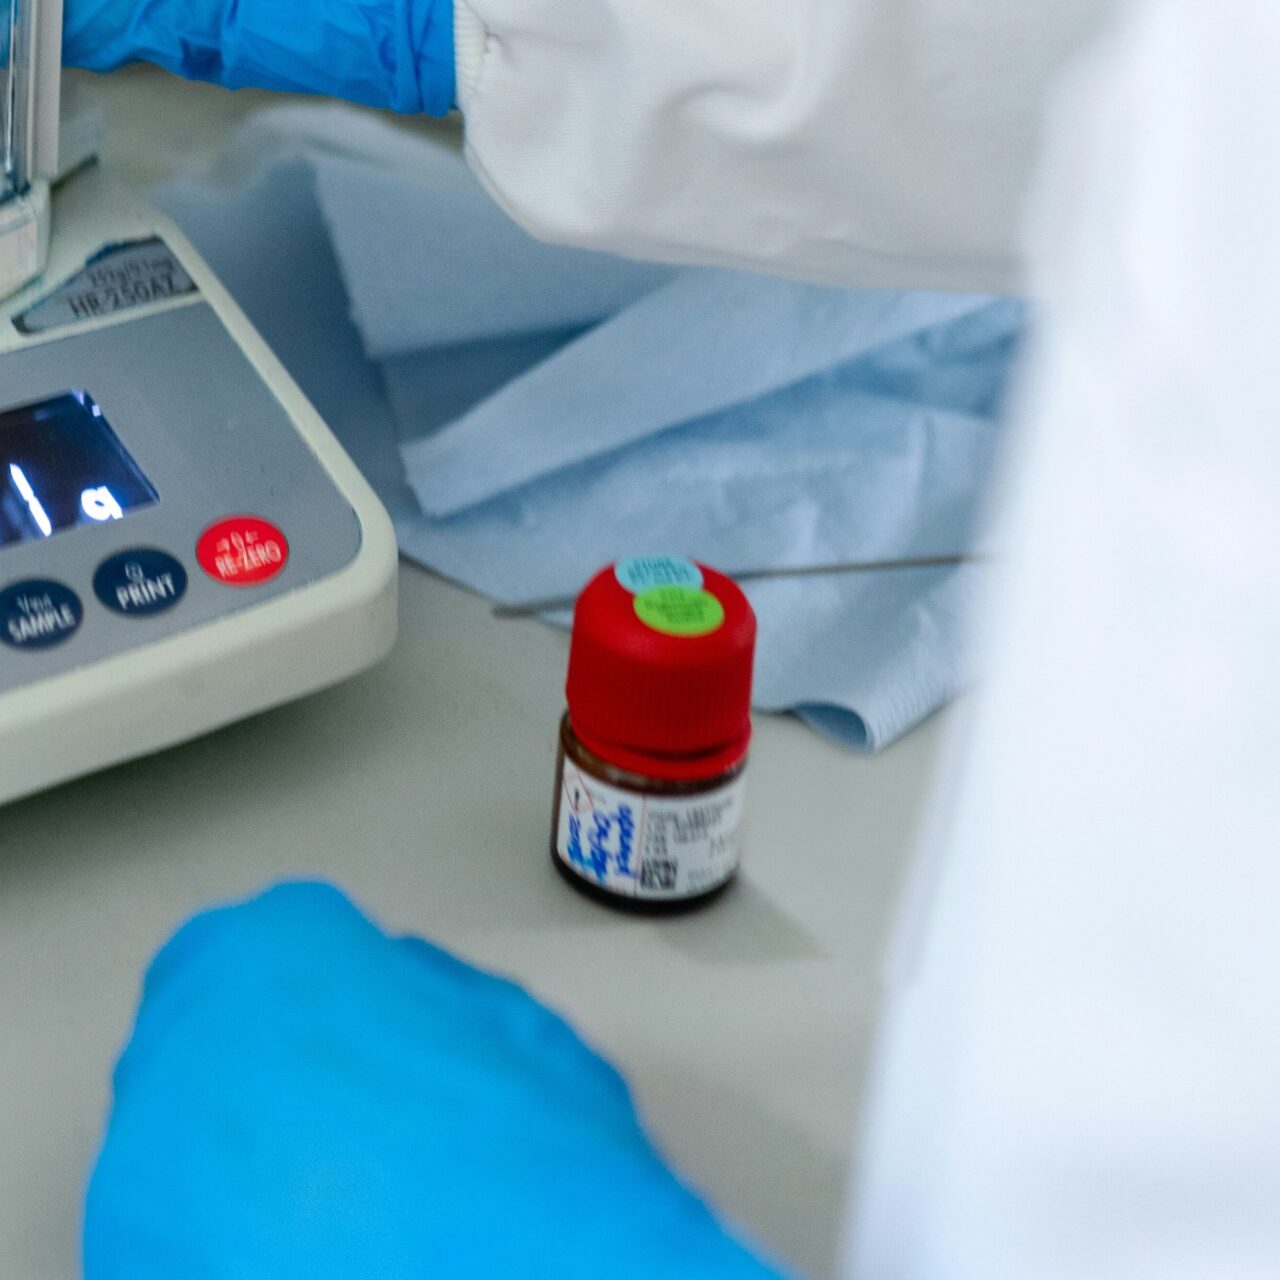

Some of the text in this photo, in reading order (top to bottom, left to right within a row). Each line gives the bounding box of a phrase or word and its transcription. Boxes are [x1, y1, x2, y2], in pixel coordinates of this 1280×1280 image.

[215, 539, 282, 578] RE-ZERO
[116, 572, 176, 611] PRINT
[8, 602, 75, 641] SAMPLE
